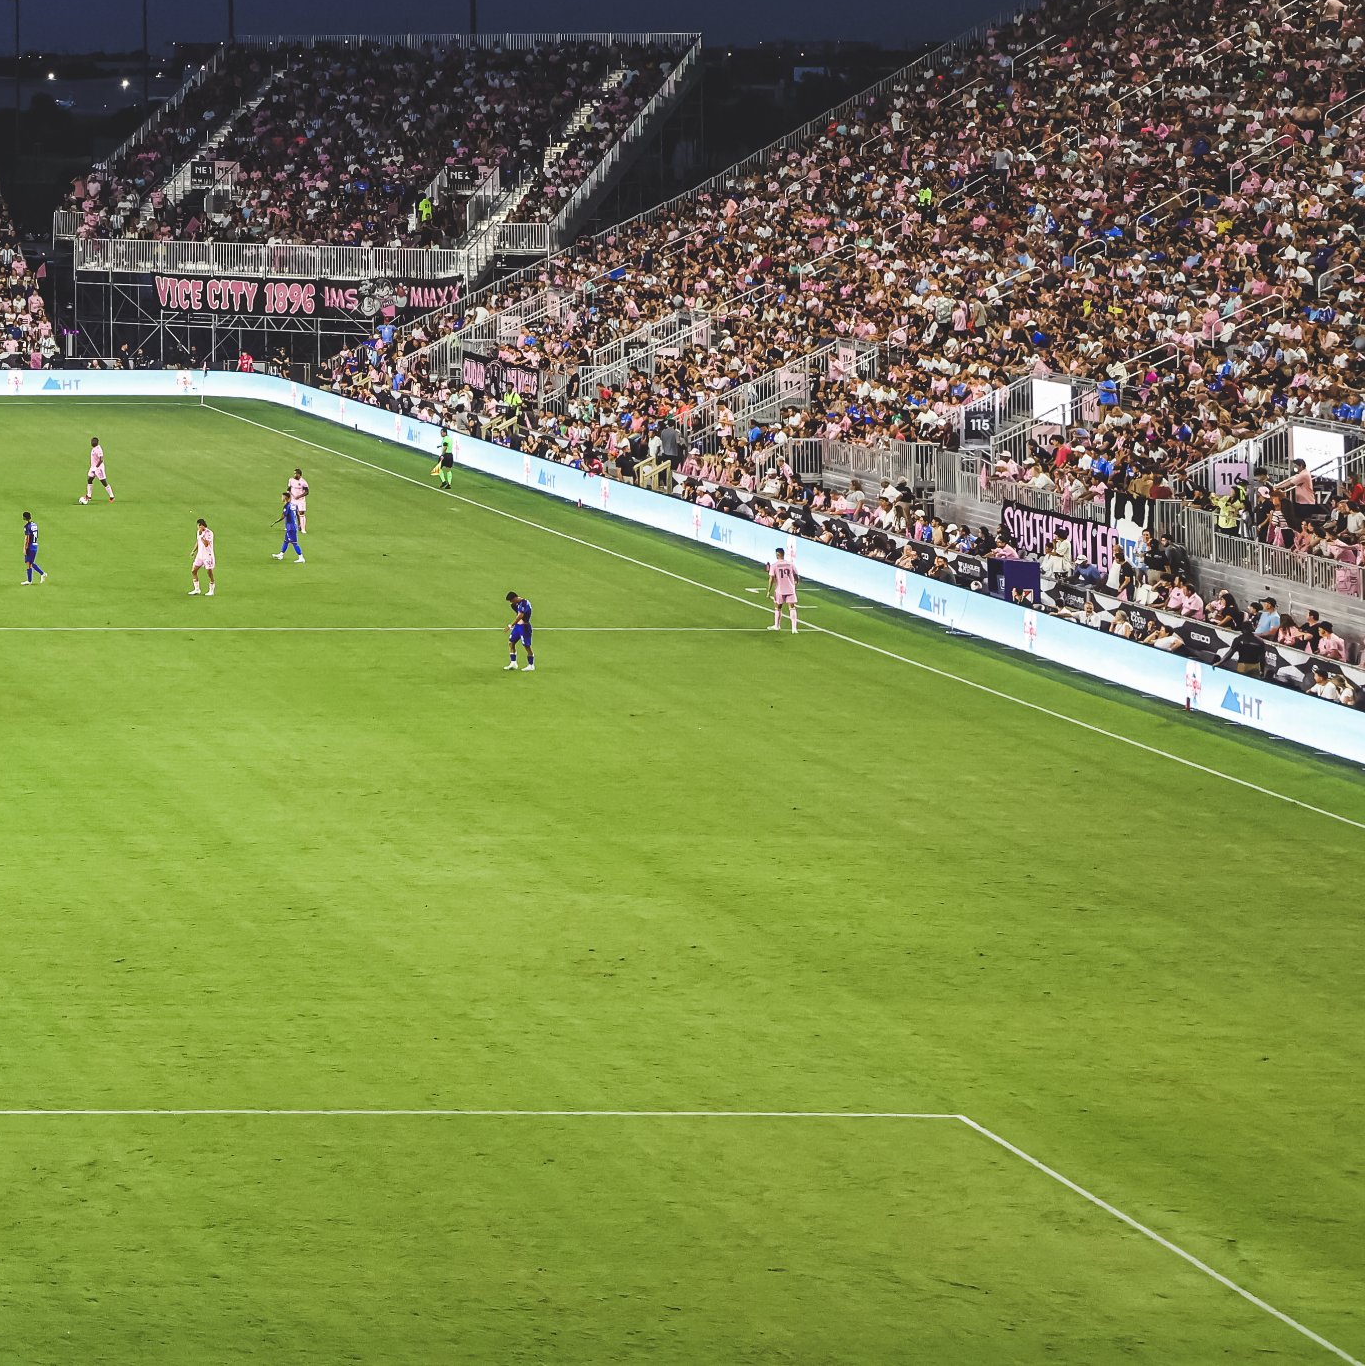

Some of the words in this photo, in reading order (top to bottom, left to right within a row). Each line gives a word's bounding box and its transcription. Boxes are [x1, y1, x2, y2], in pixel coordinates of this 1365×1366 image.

[195, 166, 212, 174] NE1
[155, 275, 203, 310] VICE
[207, 279, 258, 313] CITY
[263, 282, 316, 315] 1896
[969, 419, 990, 431] 115
[1221, 472, 1242, 486] 116
[778, 568, 790, 579] 19
